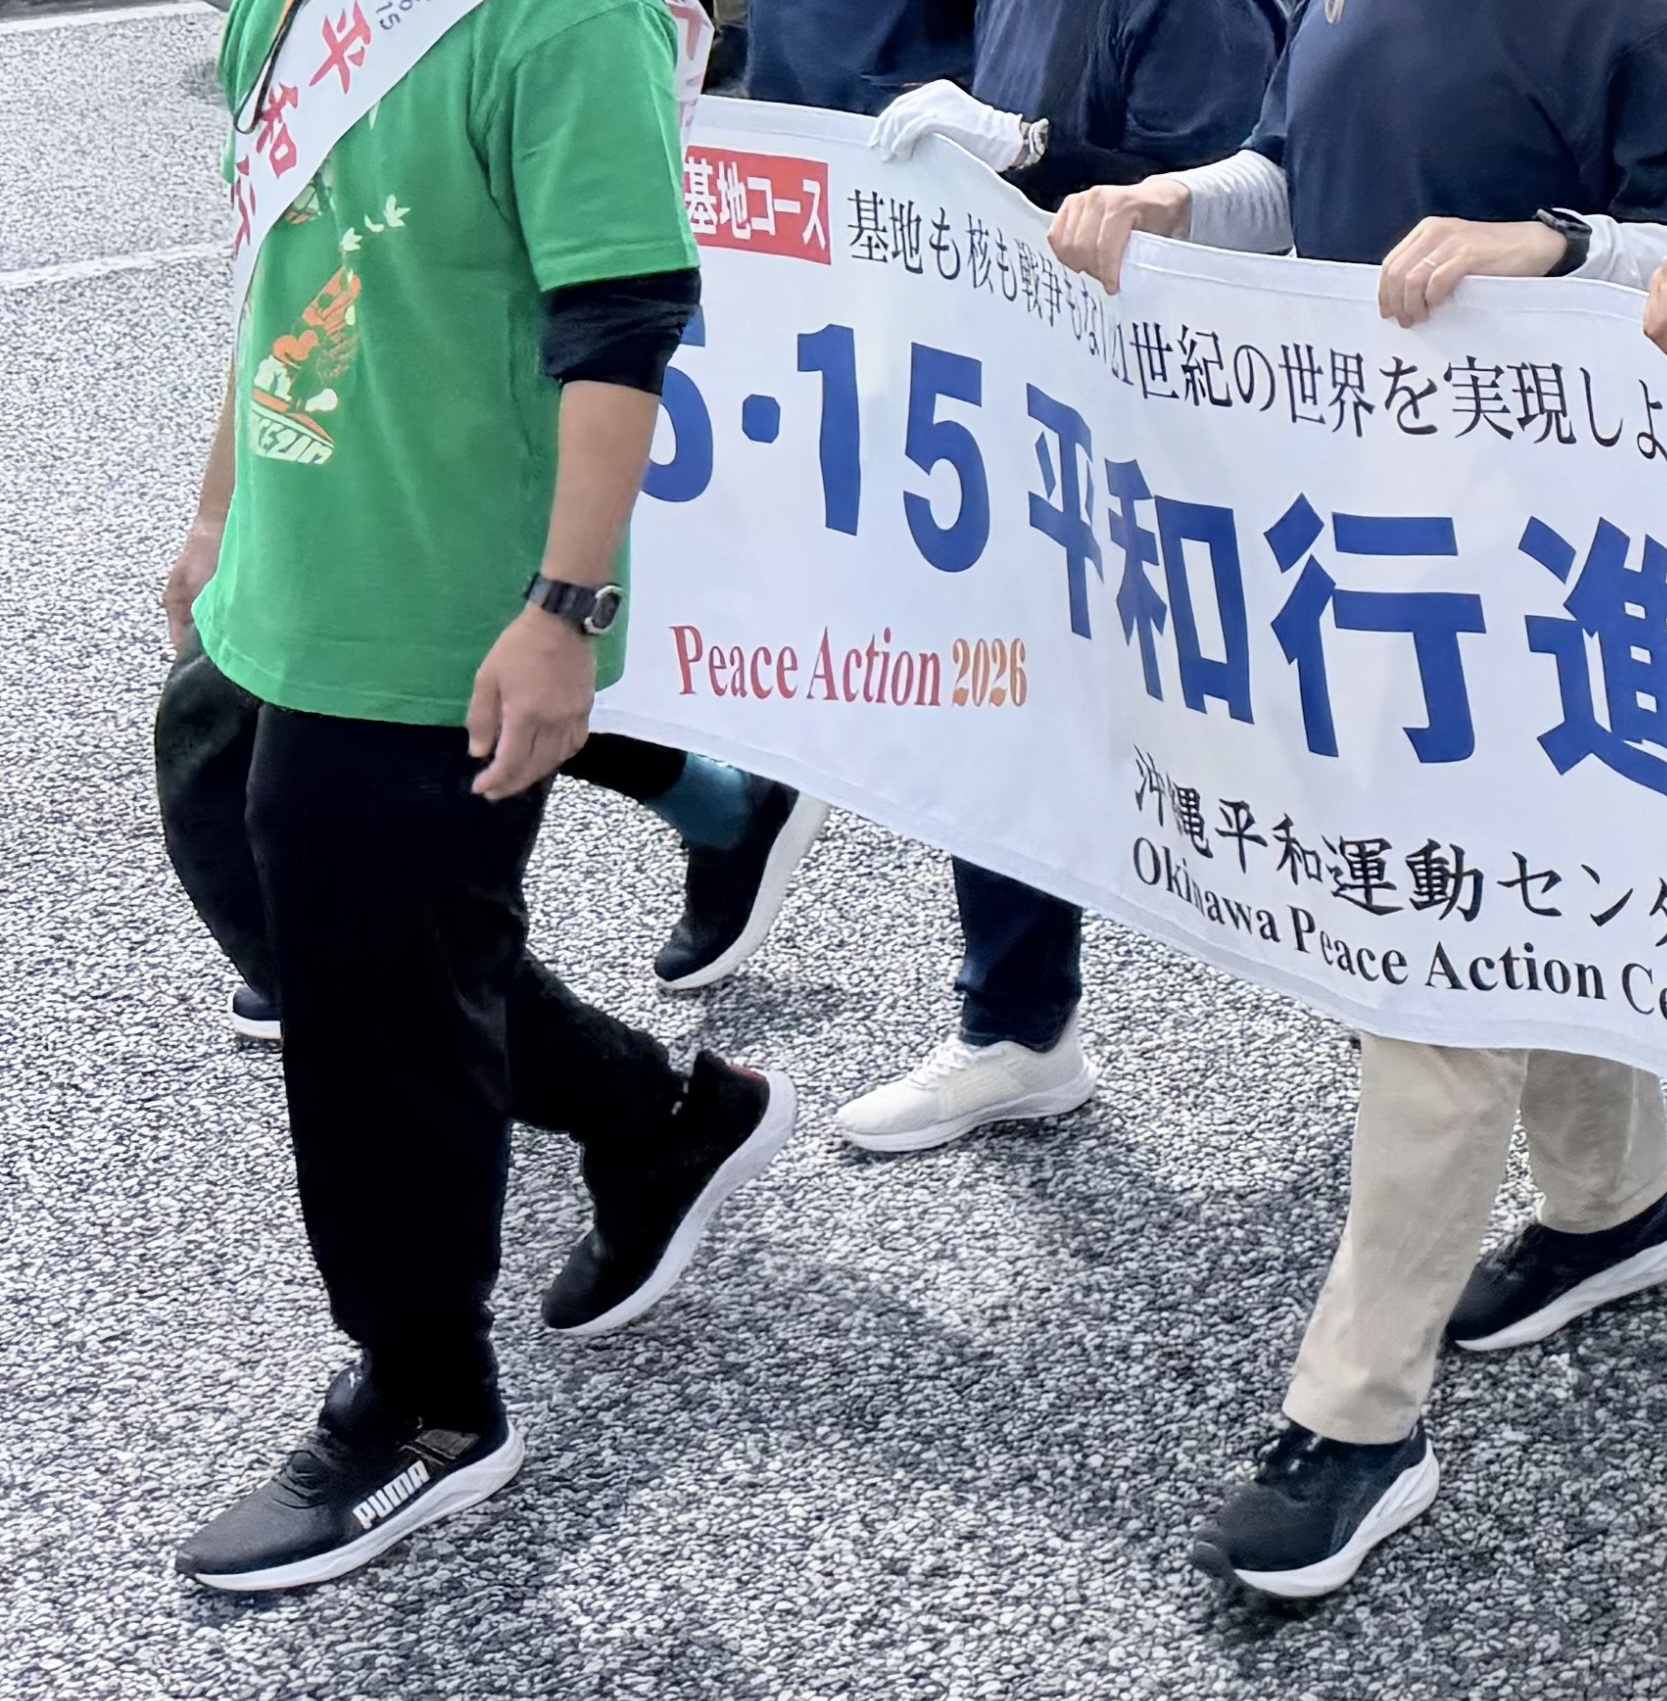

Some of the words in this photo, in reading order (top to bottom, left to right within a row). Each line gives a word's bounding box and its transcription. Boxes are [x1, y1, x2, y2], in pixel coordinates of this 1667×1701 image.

[684, 153, 828, 251] 基地コース
[670, 621, 800, 701] Peace
[807, 626, 941, 708] Action
[951, 636, 1029, 708] 2026
[1133, 835, 1282, 944] Okinawa
[1288, 905, 1409, 986] Peace
[1424, 940, 1607, 1001] Action
[351, 1461, 432, 1529] PUMA
